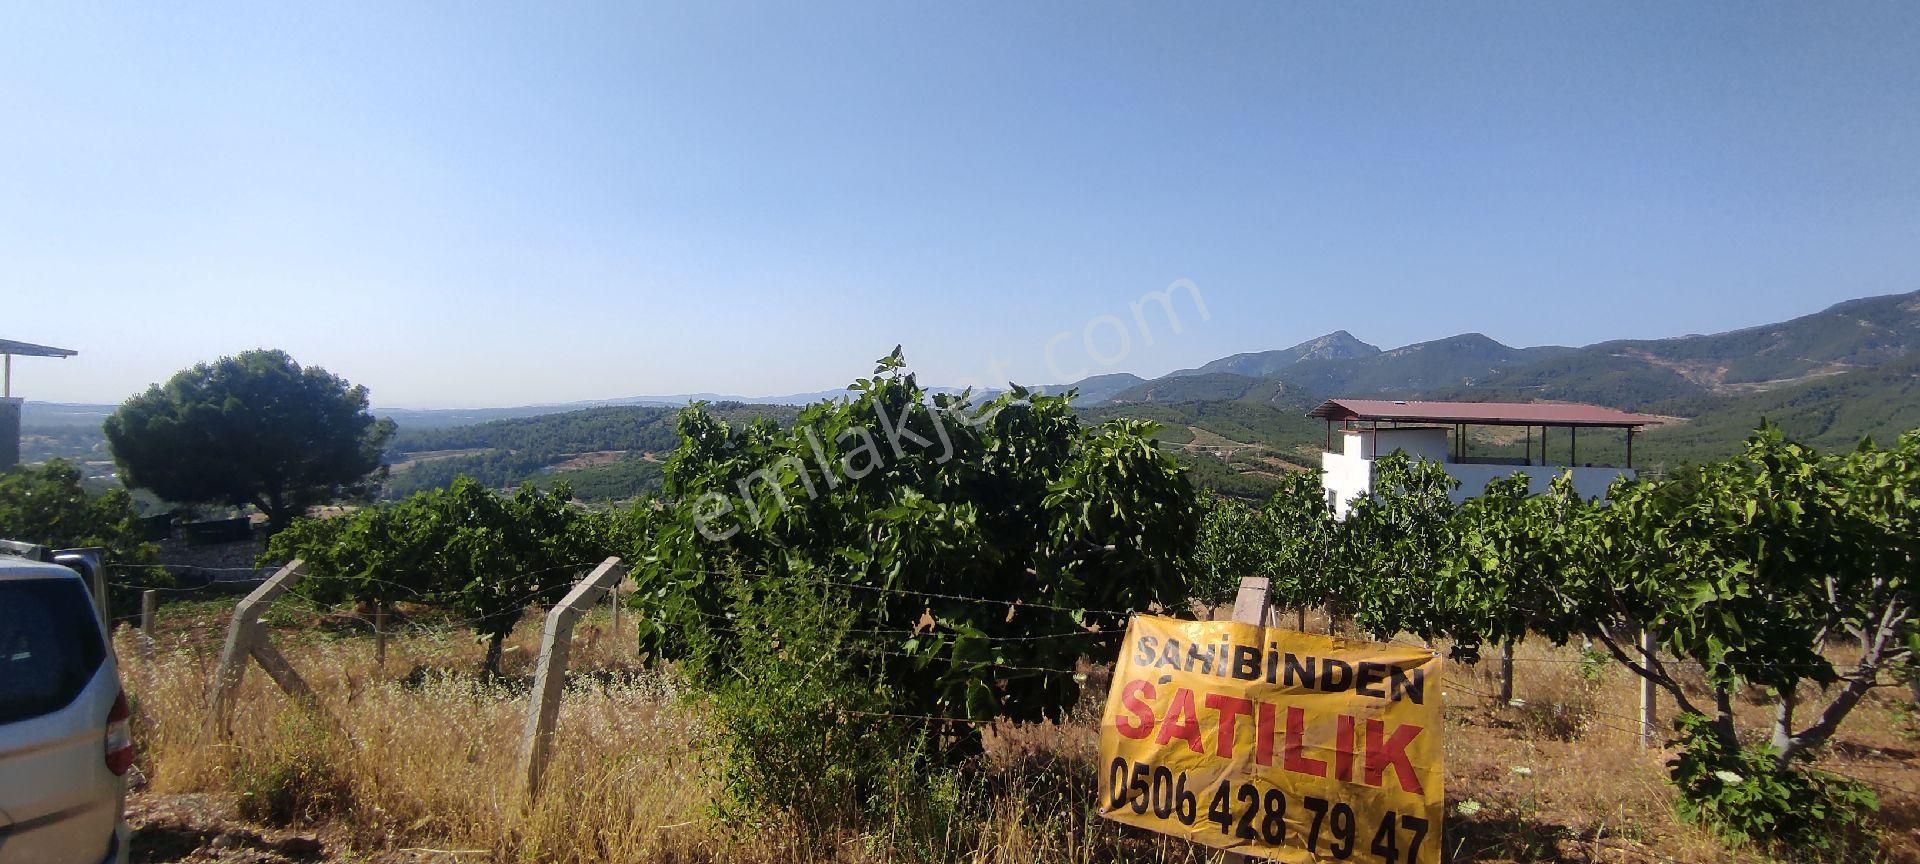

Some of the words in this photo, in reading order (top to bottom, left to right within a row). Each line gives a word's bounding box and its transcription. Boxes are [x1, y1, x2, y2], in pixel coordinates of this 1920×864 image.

[1114, 680, 1425, 796] SATILIK
[1110, 757, 1197, 826] 0506
[1208, 780, 1287, 846] 428
[1303, 796, 1356, 860] 79
[1371, 811, 1429, 864] 47
